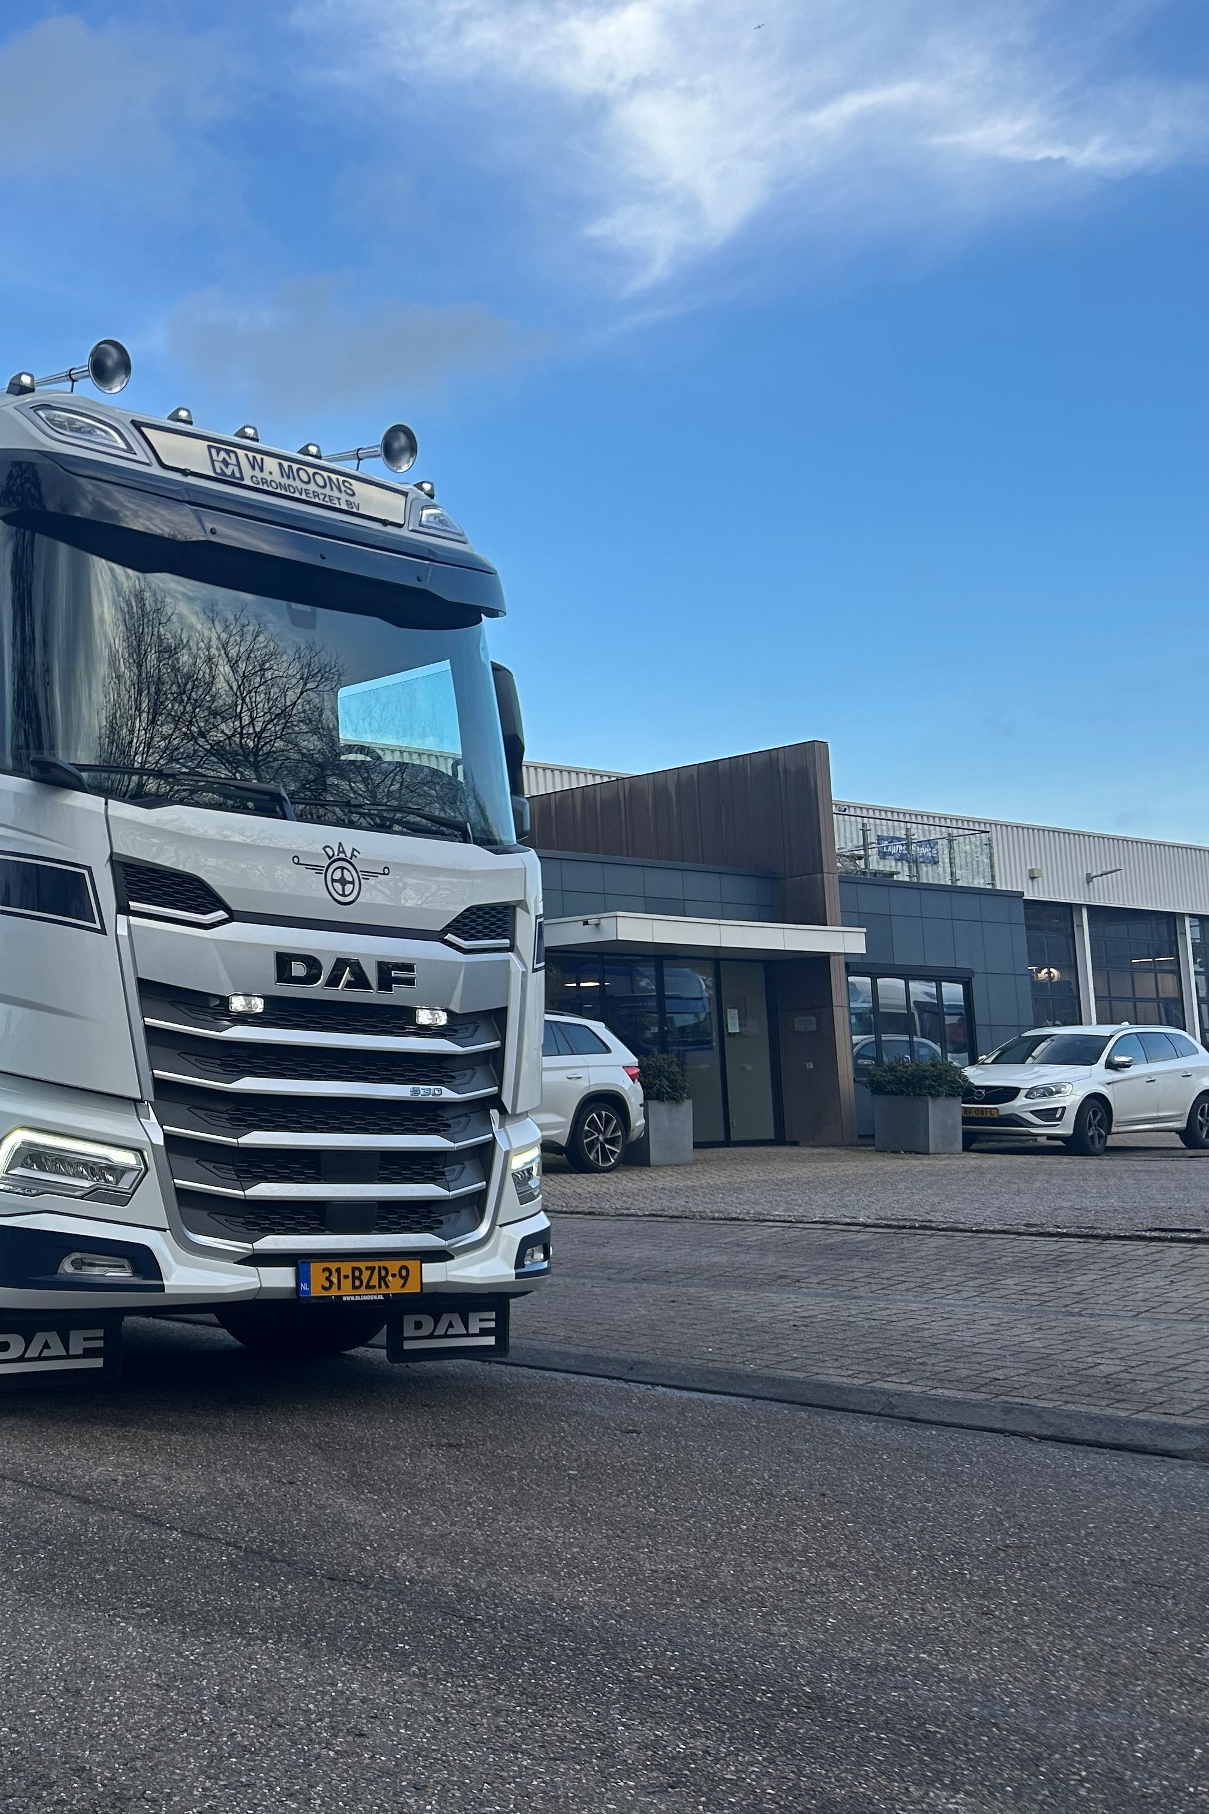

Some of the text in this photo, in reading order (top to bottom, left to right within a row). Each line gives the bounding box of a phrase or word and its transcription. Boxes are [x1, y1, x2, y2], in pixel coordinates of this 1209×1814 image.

[244, 452, 356, 497] W. MOONS
[250, 474, 360, 512] GRONDVERZET BV
[321, 841, 361, 861] DAF
[273, 950, 418, 994] DAF
[409, 1086, 443, 1097] 530
[300, 1282, 310, 1291] NL
[320, 1264, 411, 1292] 31-BZR-9
[403, 1311, 496, 1338] DAF
